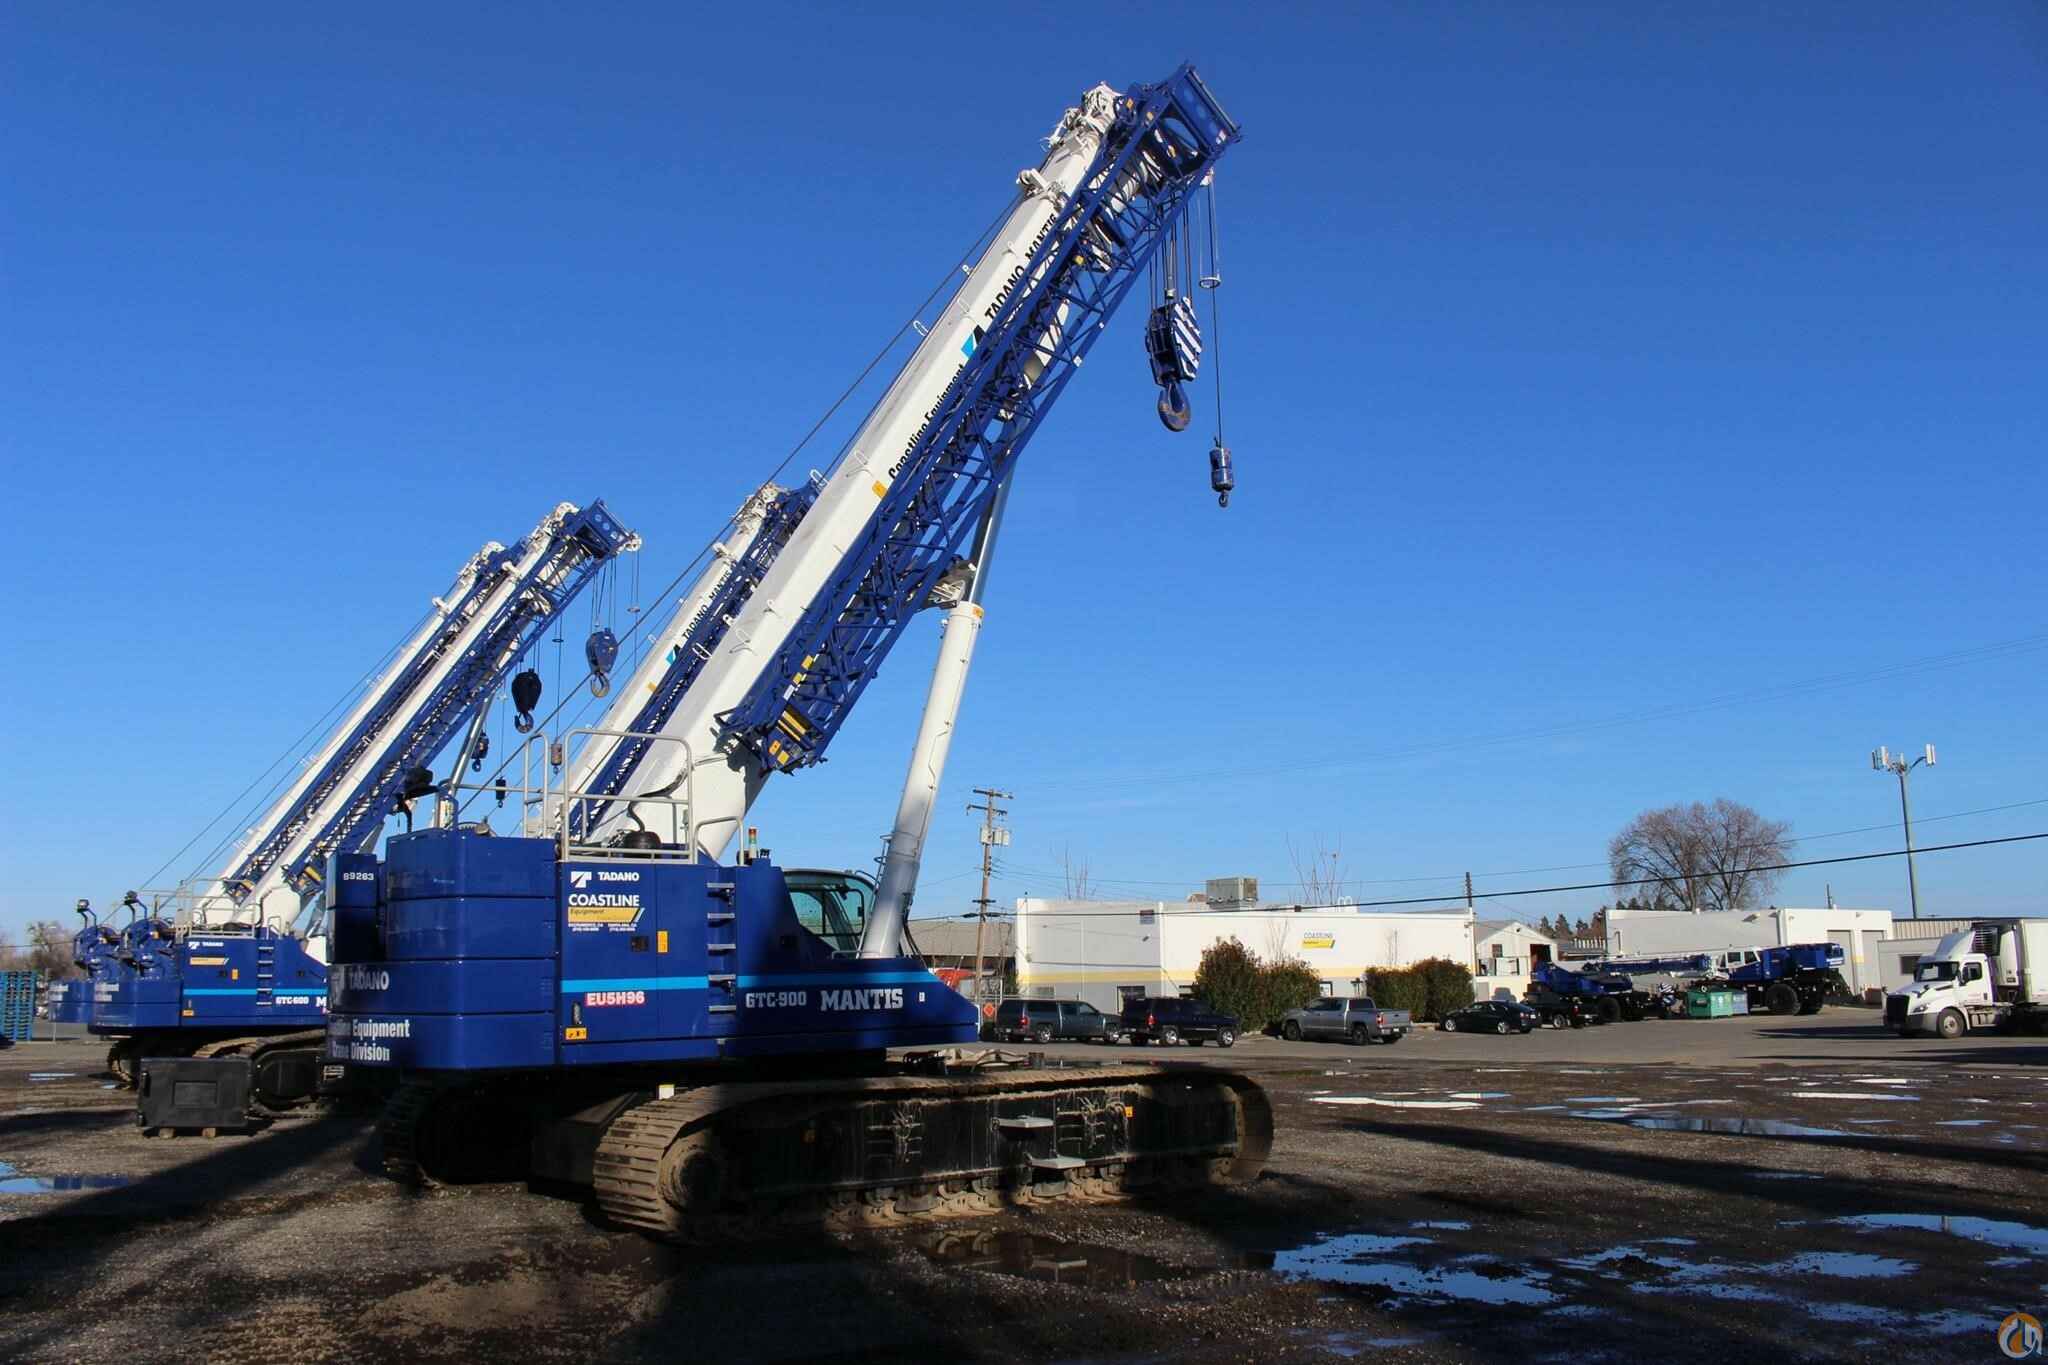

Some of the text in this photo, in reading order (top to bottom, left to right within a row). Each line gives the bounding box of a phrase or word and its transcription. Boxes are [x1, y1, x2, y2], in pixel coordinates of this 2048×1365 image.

[597, 871, 640, 881] TADANO
[568, 894, 640, 907] COASTLINE
[745, 991, 807, 1008] GTC-900
[820, 988, 904, 1011] MANTIS
[352, 1019, 411, 1041] Equipment
[351, 1041, 391, 1062] Division
